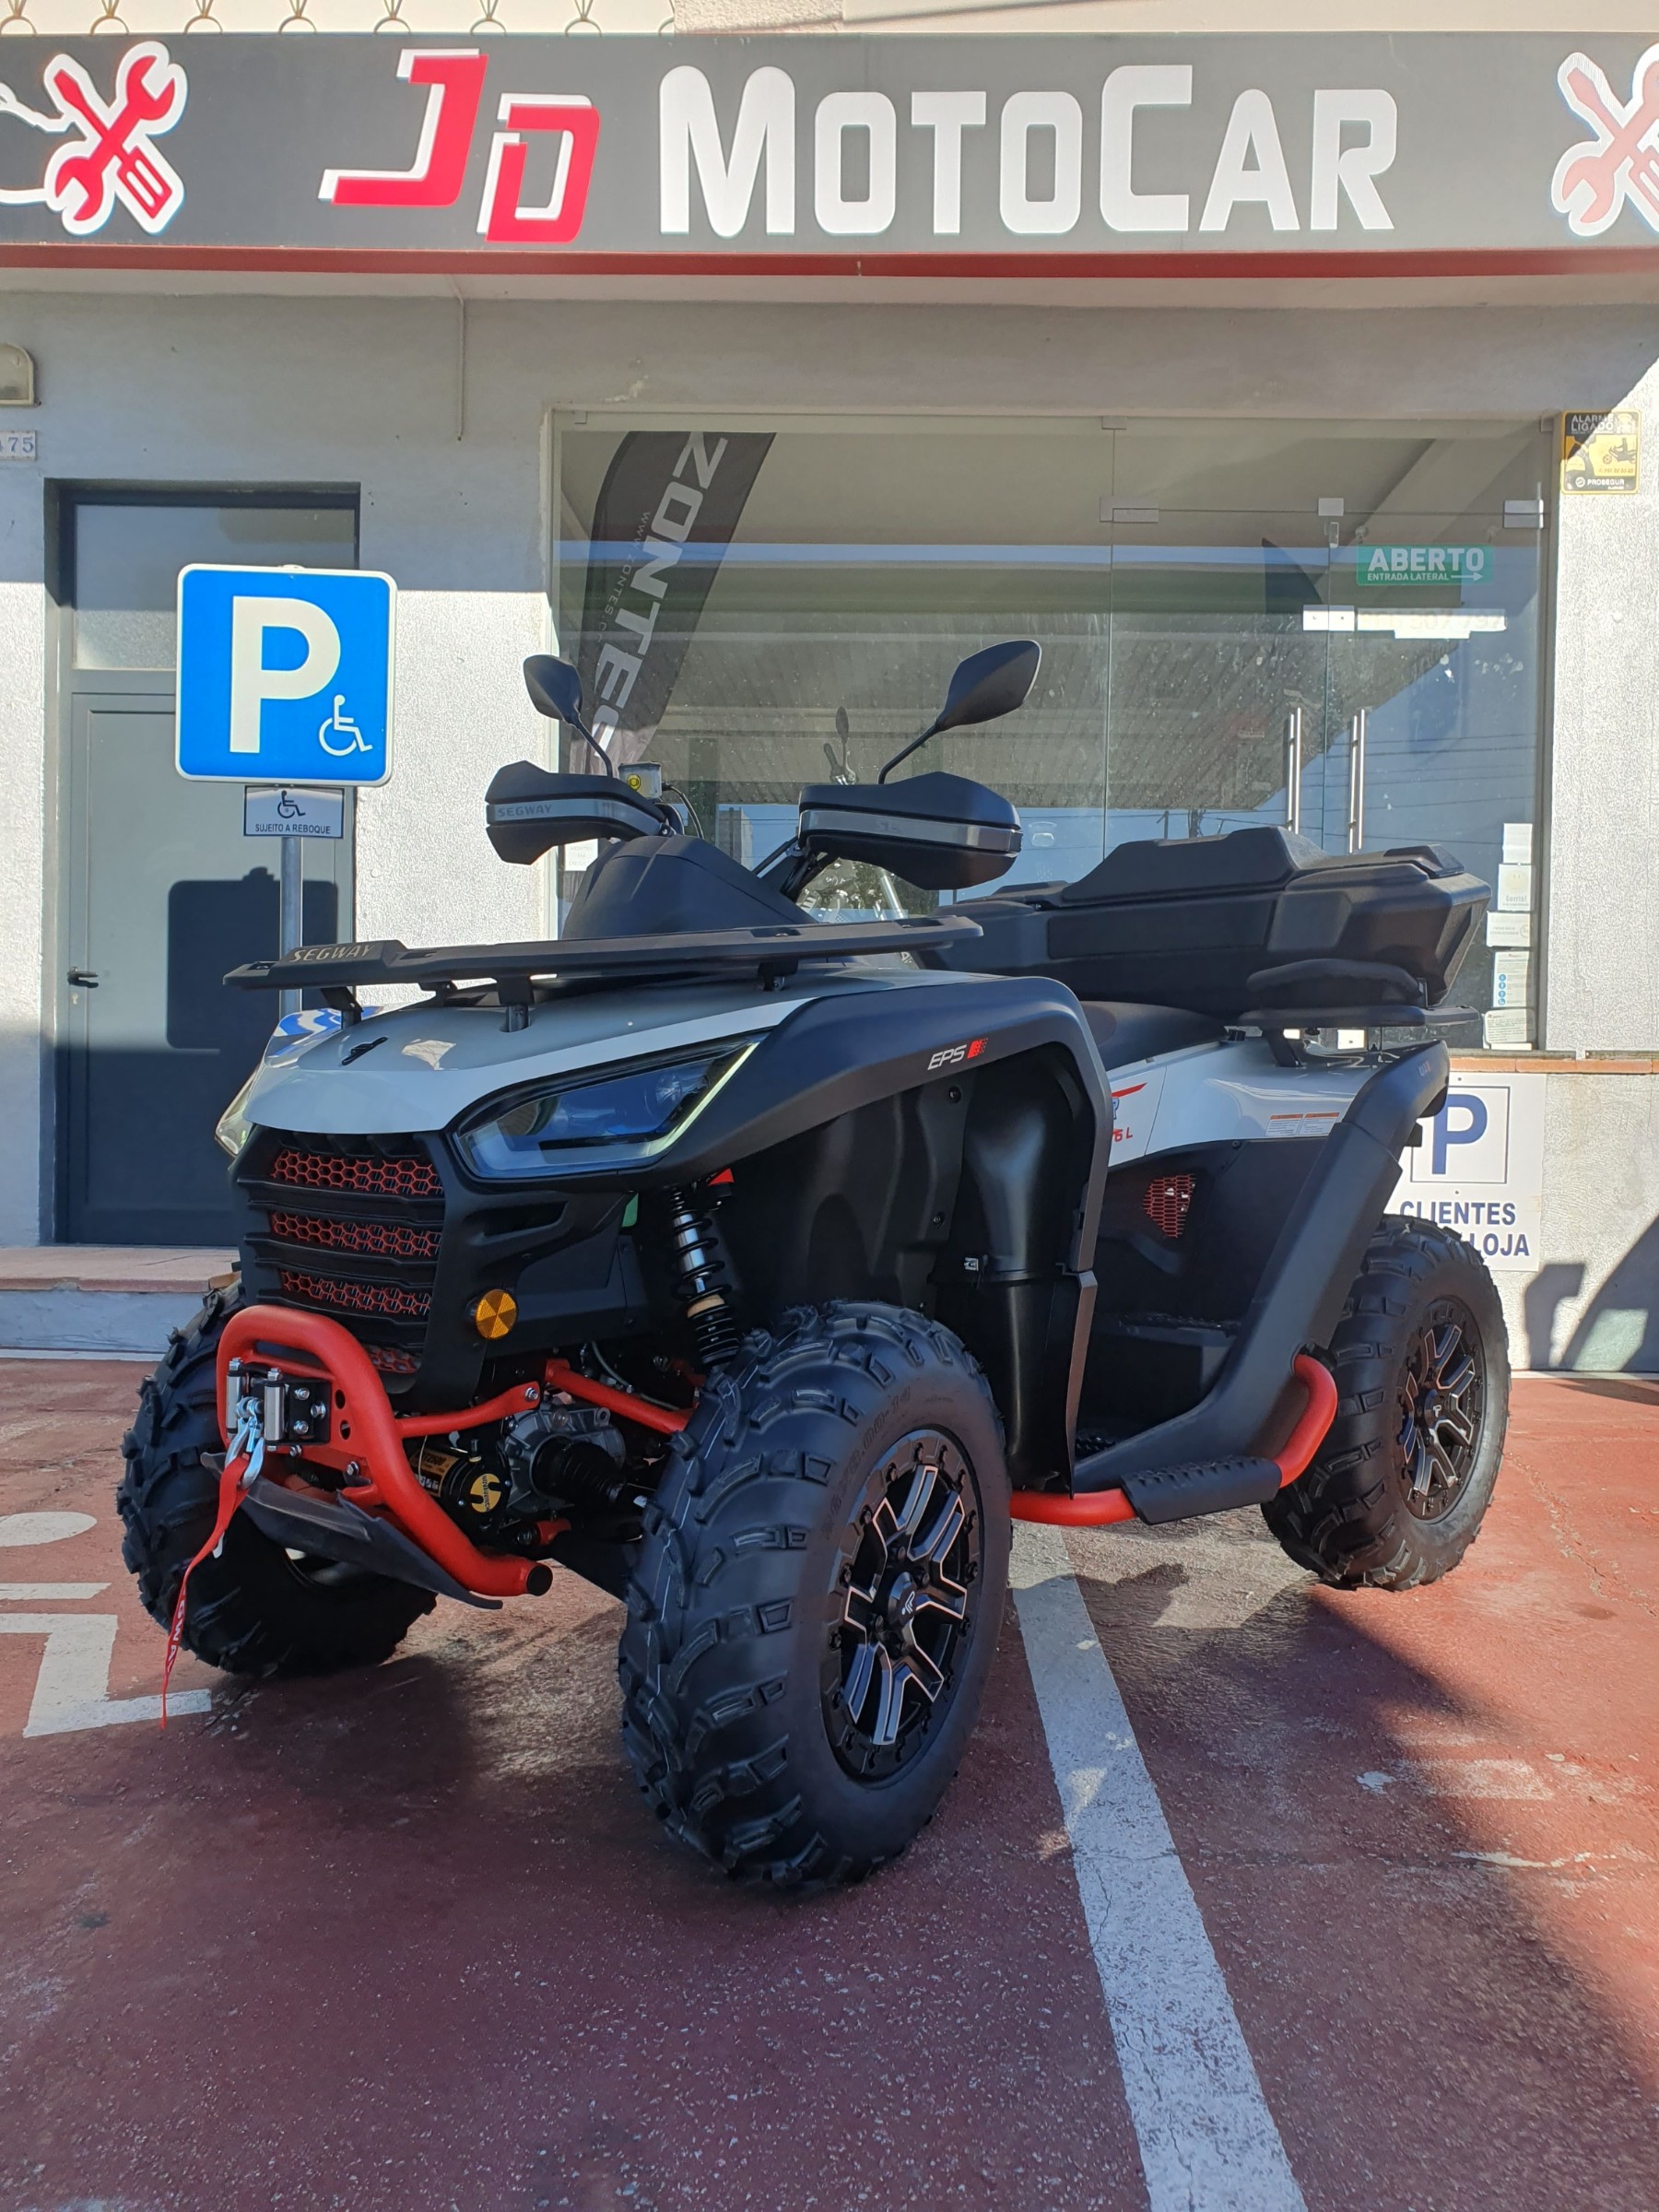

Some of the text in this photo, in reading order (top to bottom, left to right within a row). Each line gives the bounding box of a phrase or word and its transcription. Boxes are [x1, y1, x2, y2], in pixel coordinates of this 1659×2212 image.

[317, 48, 601, 244] JD
[1571, 422, 1615, 432] LIGADO
[1368, 547, 1485, 572] ABERTO
[1367, 572, 1449, 582] ENTRADA LATERAL
[229, 595, 341, 754] P
[498, 804, 553, 818] SEGWAY
[255, 823, 331, 834] SUJEITO A REBOQUE
[288, 944, 376, 962] SEGWAY
[927, 1044, 968, 1070] EPS
[1432, 1094, 1488, 1175] P
